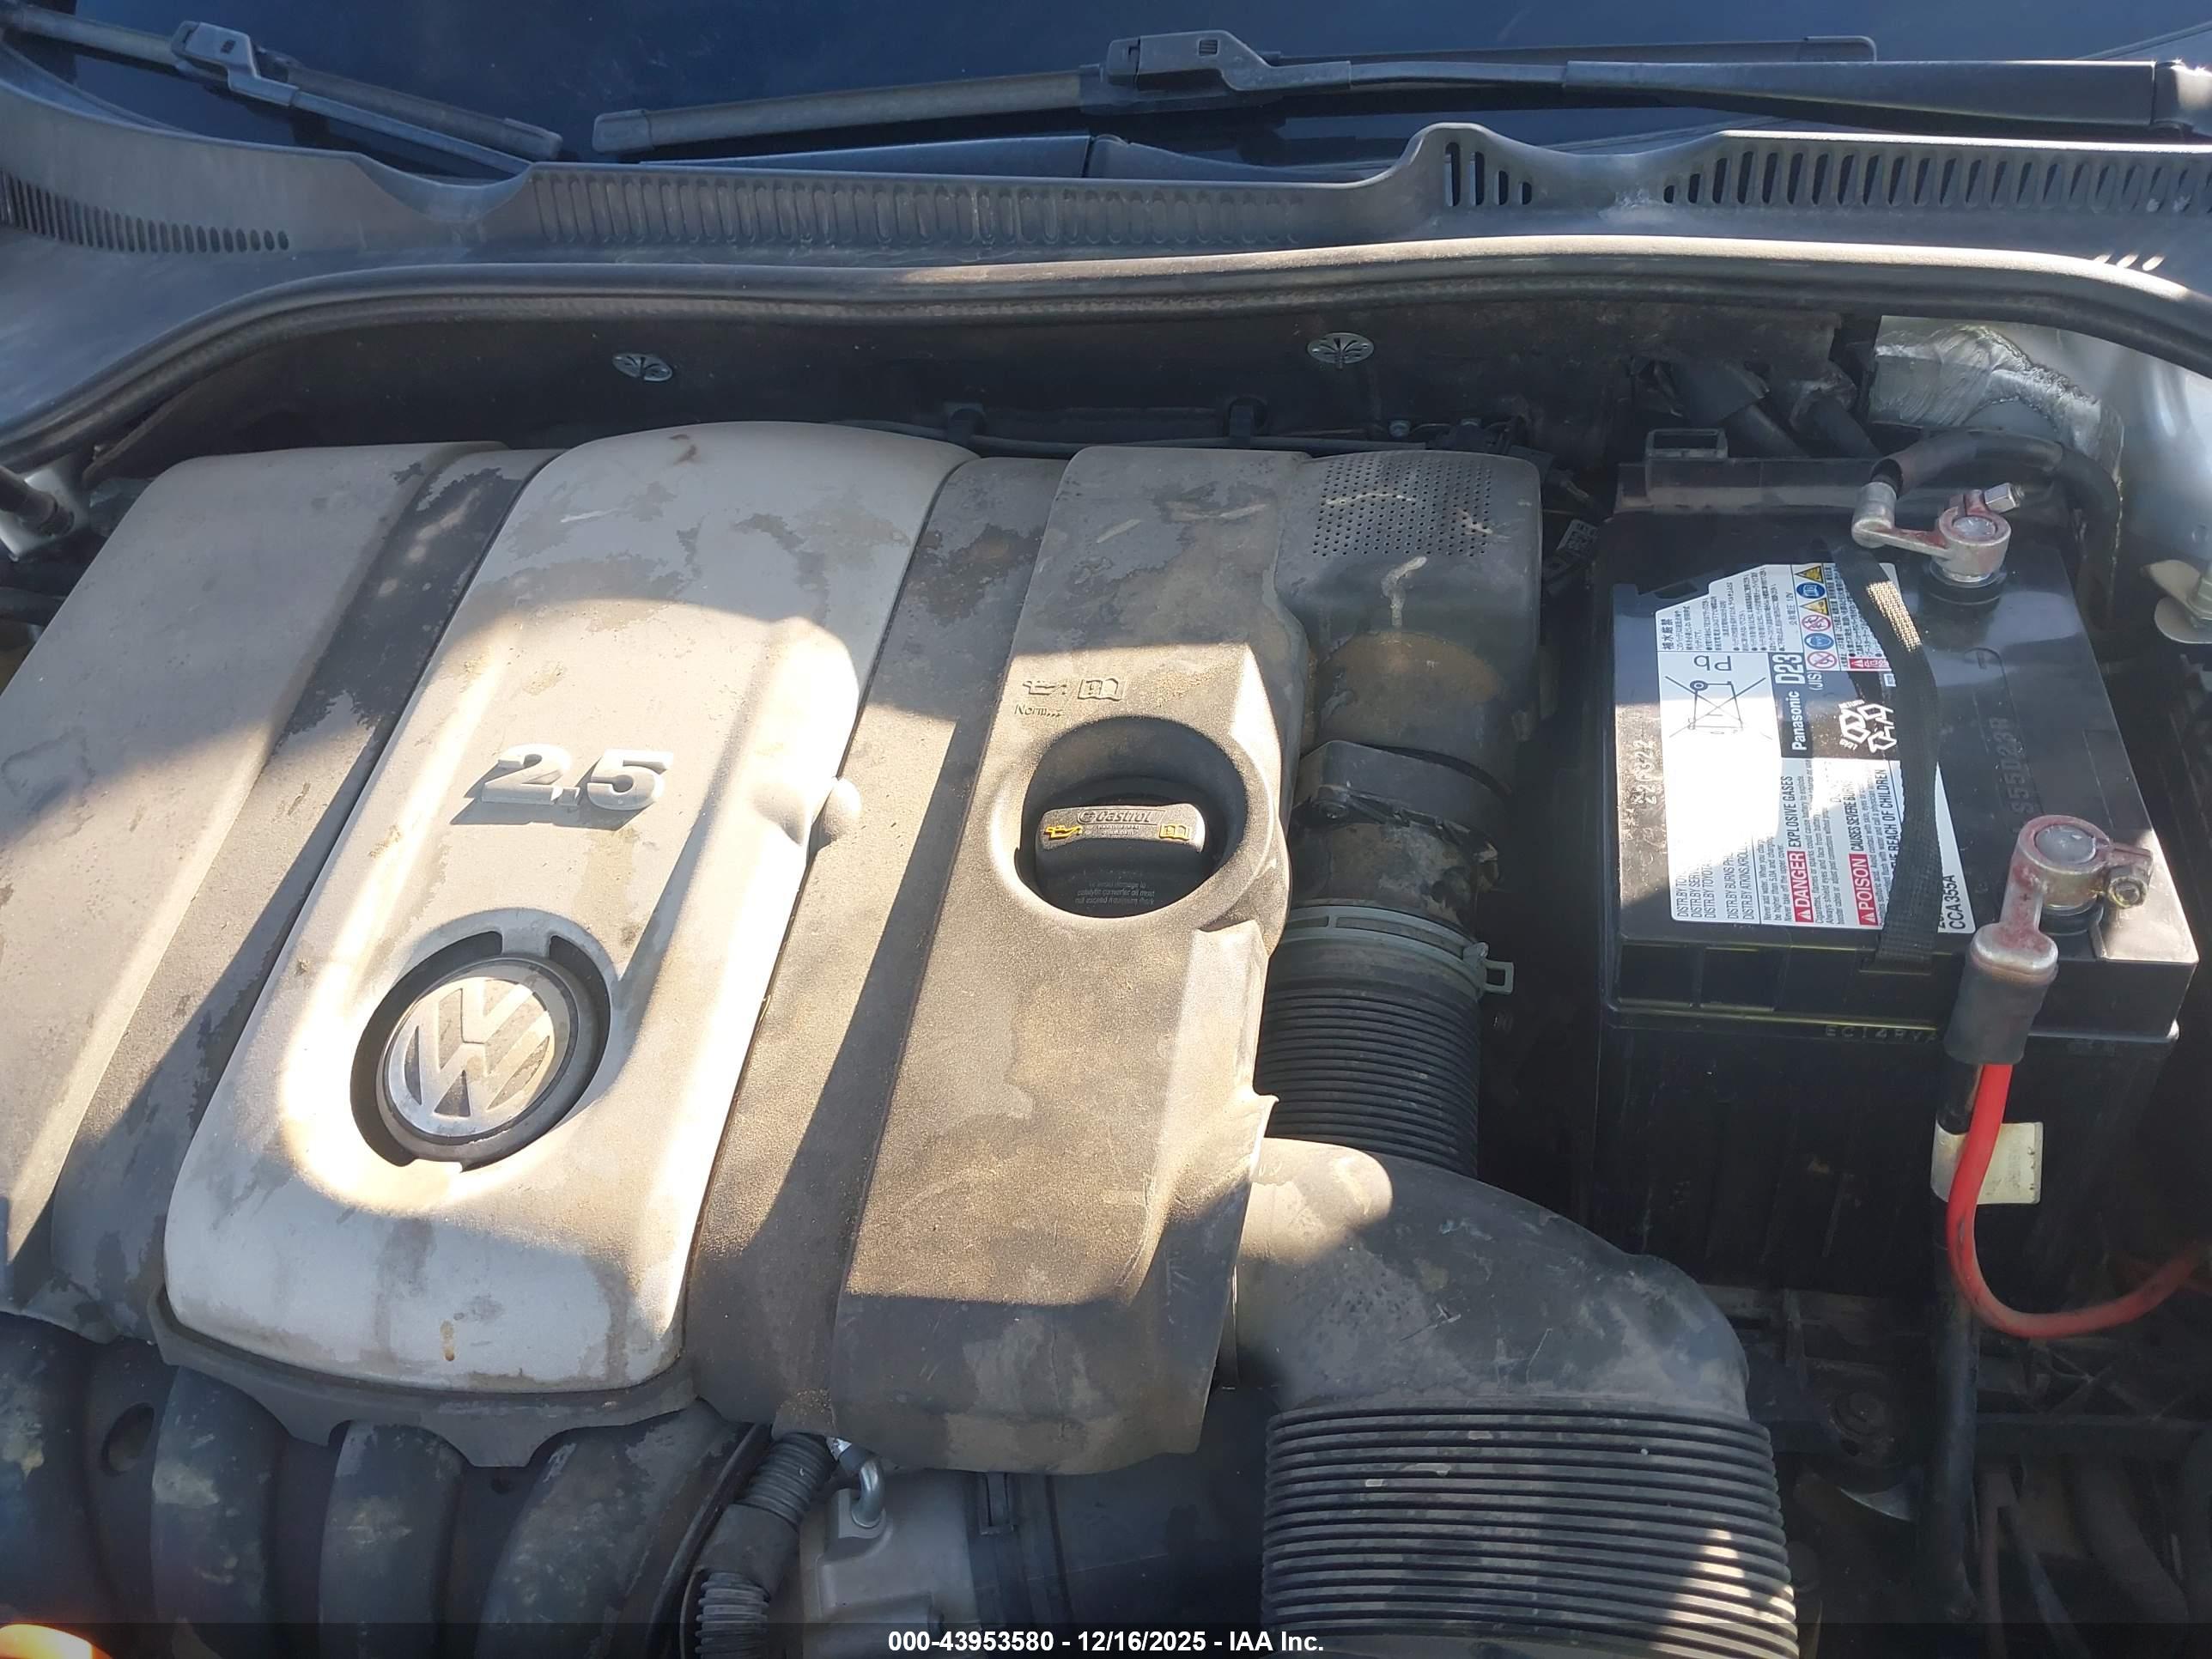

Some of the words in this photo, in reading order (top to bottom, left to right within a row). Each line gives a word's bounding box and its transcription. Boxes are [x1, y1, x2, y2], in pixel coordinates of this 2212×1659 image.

[1772, 654, 1805, 684] D23
[1807, 672, 1823, 690] (JIS)
[1786, 691, 1807, 750] Panasonic
[481, 744, 674, 811] 2.5
[1781, 775, 1796, 801] GASES
[1875, 769, 1893, 808] CHILDREN
[1096, 811, 1152, 823] Castrol
[1844, 802, 1860, 825] SEVERE
[1881, 811, 1895, 821] OF
[1784, 804, 1802, 848] EXPLOSIVE
[1806, 835, 1814, 849] could
[1814, 833, 1823, 845] from
[1847, 826, 1863, 851] CAUSES
[1883, 824, 1899, 851] REACH
[1758, 854, 1766, 864] you
[1808, 850, 1818, 866] sparks
[1816, 847, 1825, 858] face
[1778, 860, 1787, 874] upper
[1818, 860, 1826, 869] and
[1789, 853, 1811, 908] DANGER
[1820, 872, 1829, 884] eyes
[1851, 858, 1874, 910] POISON
[1821, 885, 1831, 902] shield
[1823, 905, 1834, 924] Always
